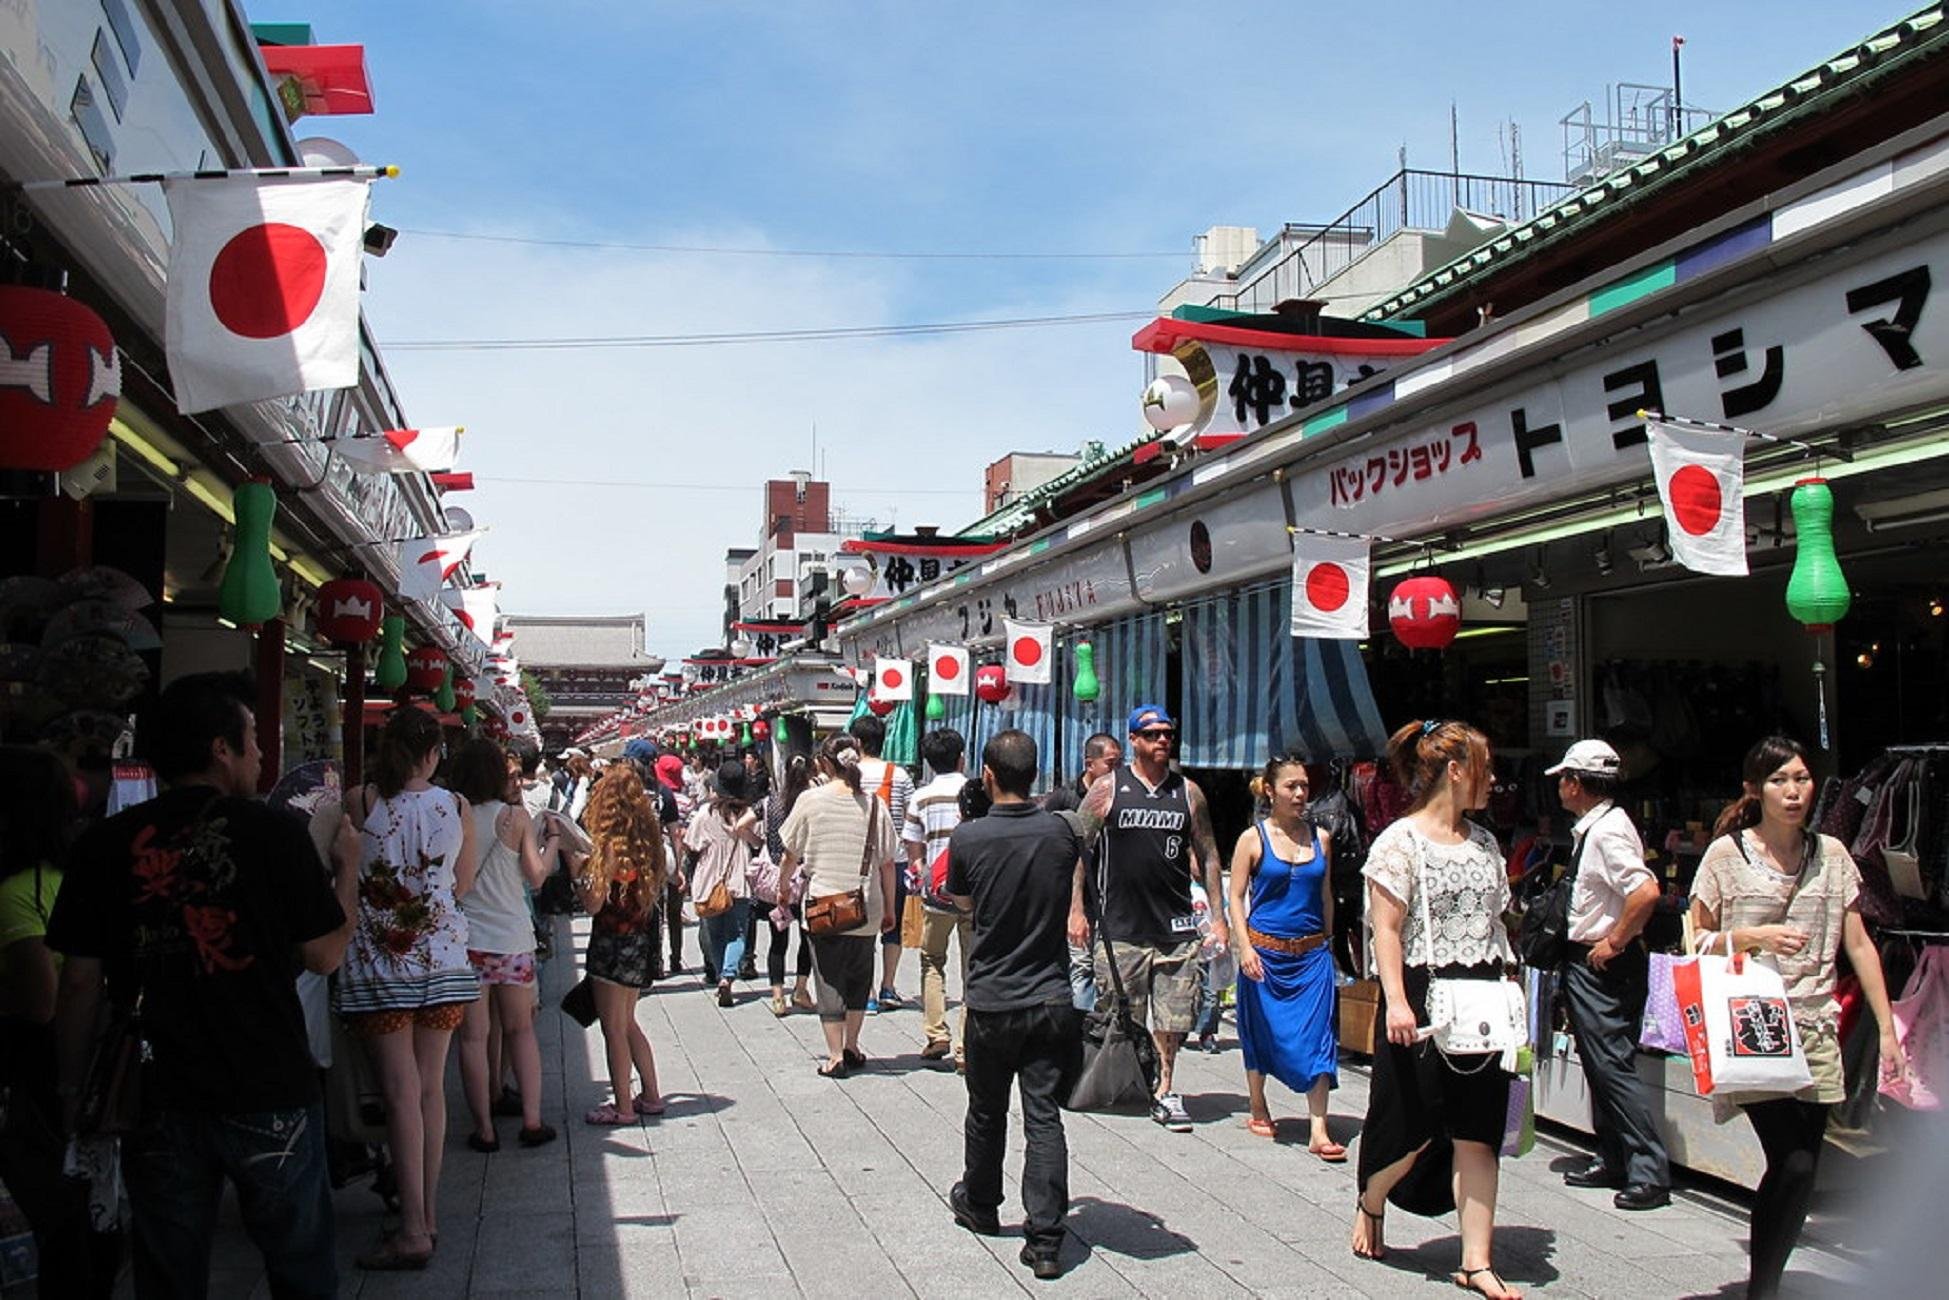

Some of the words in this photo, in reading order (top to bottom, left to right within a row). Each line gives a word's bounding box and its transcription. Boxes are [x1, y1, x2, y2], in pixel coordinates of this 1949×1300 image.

[1228, 353, 1387, 426] 仲見
[1329, 420, 1482, 506] バックショップ
[1511, 264, 1931, 478] トヨシマ
[1118, 808, 1185, 831] MIAMI
[1165, 835, 1183, 859] 6
